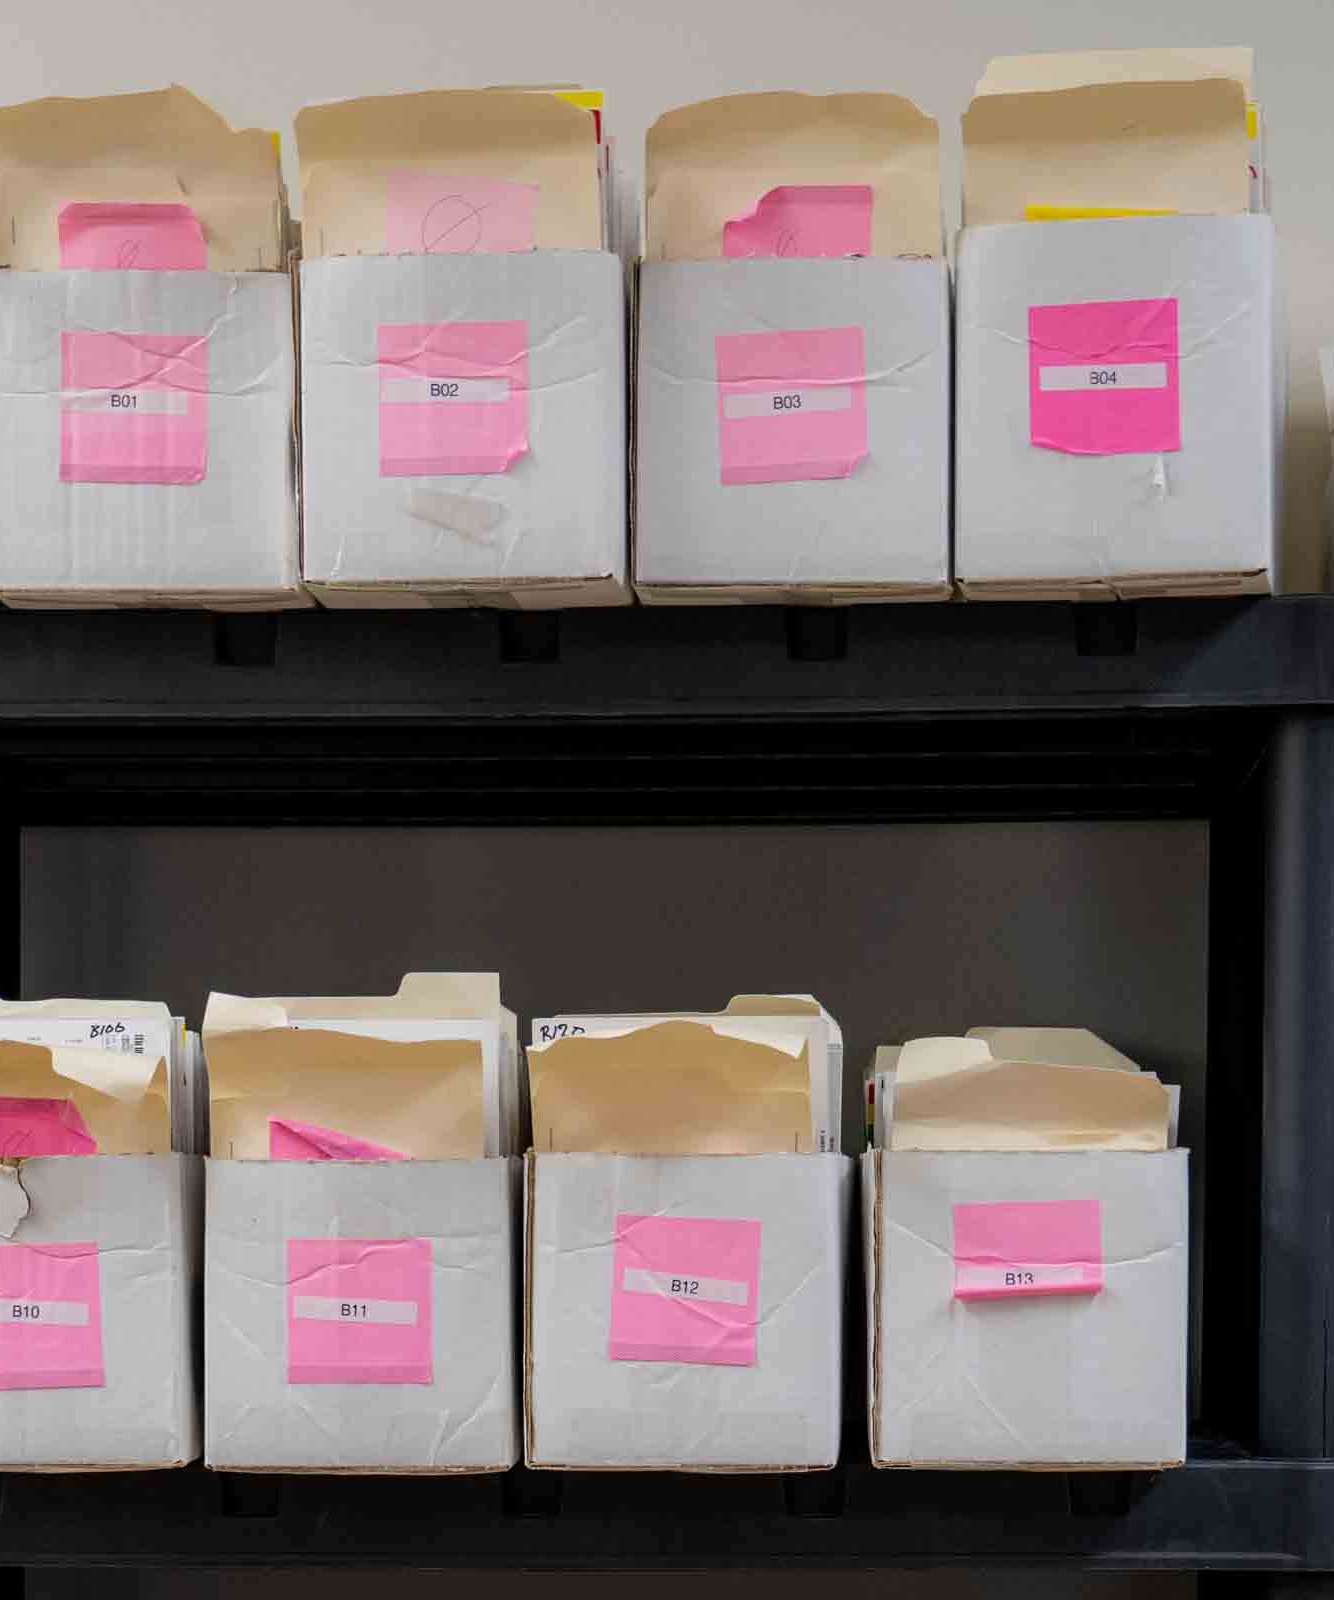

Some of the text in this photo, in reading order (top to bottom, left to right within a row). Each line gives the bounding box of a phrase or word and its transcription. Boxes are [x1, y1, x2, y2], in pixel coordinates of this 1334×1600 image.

[1090, 371, 1117, 385] B04
[430, 383, 460, 397] B02
[110, 395, 138, 408] B01
[773, 395, 802, 410] B03
[1005, 1272, 1034, 1286] B13
[671, 1279, 699, 1294] B12
[12, 1304, 40, 1319] B10
[341, 1303, 367, 1318] B11
